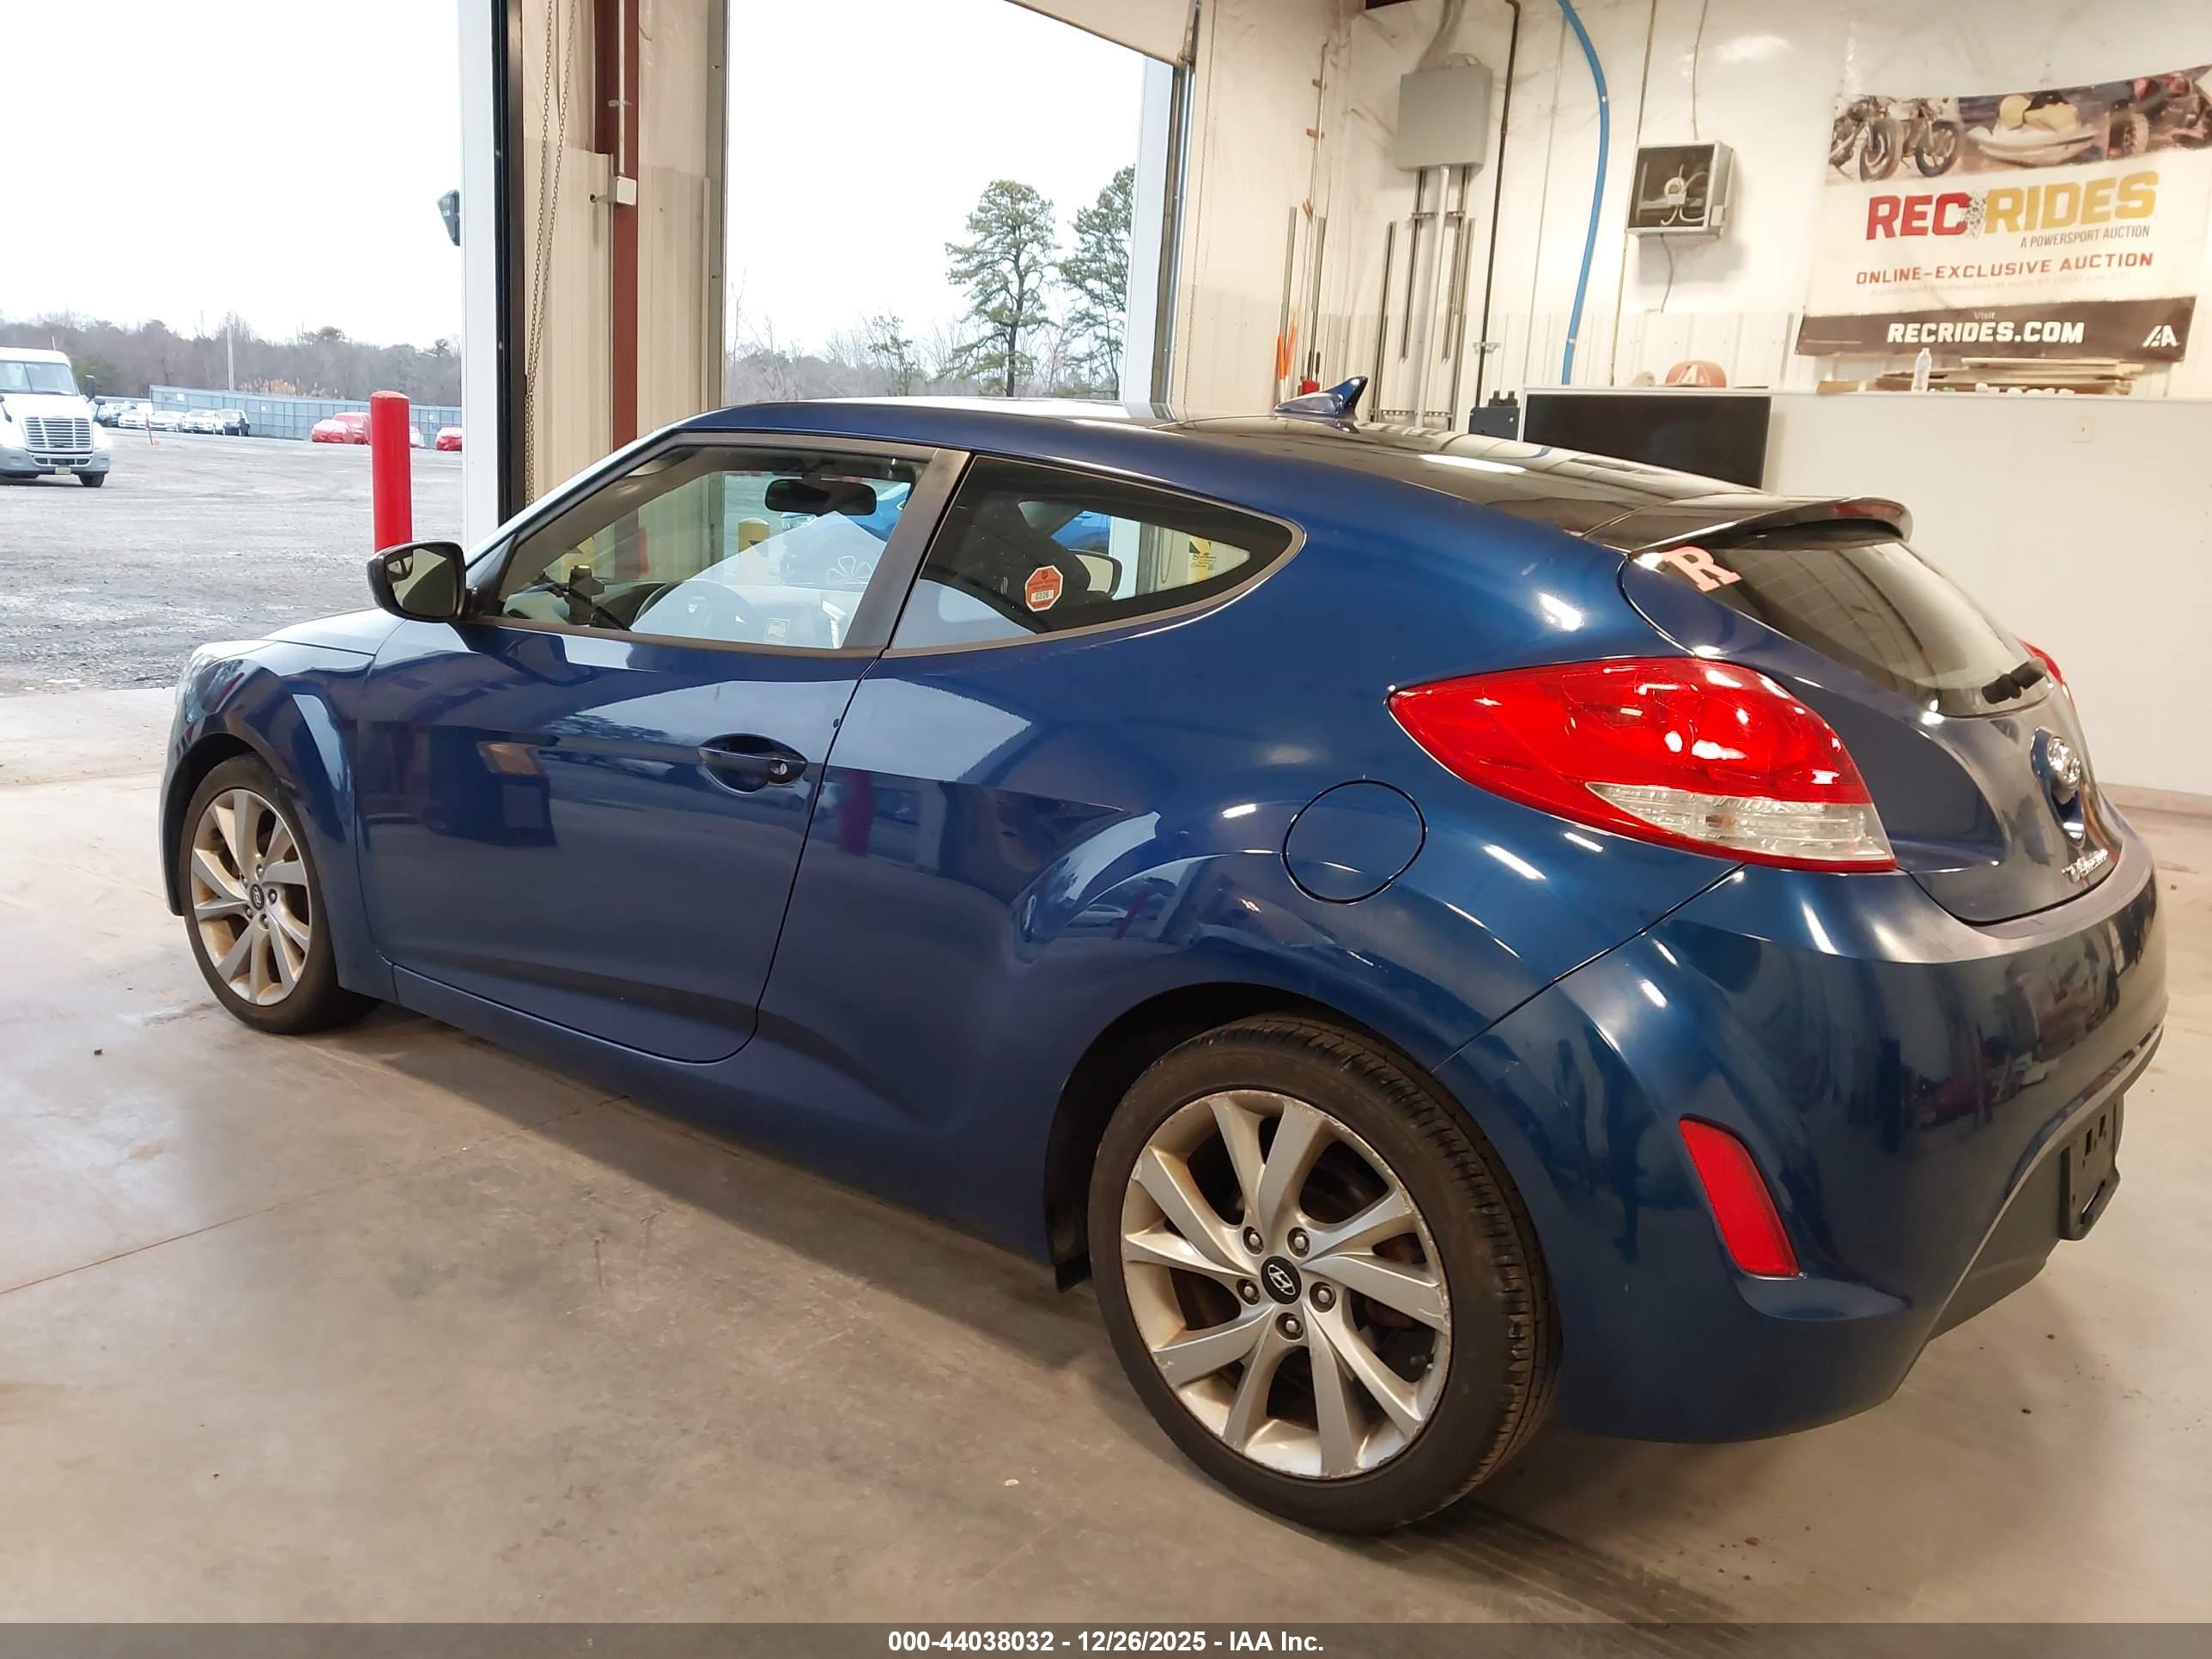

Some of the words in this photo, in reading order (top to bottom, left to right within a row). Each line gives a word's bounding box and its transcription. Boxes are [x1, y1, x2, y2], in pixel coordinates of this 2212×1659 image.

[1866, 192, 1972, 240] REC
[1984, 171, 2159, 234] RIDES
[2020, 237, 2027, 249] A
[2030, 228, 2101, 248] POWERSPORT
[2102, 225, 2150, 240] AUCTION
[1856, 259, 2052, 285] ONLINE-EXCLUSIVE
[2059, 252, 2154, 272] AUCTION
[1887, 321, 2085, 343] RECRIDES.COM
[1035, 591, 1049, 600] 0226
